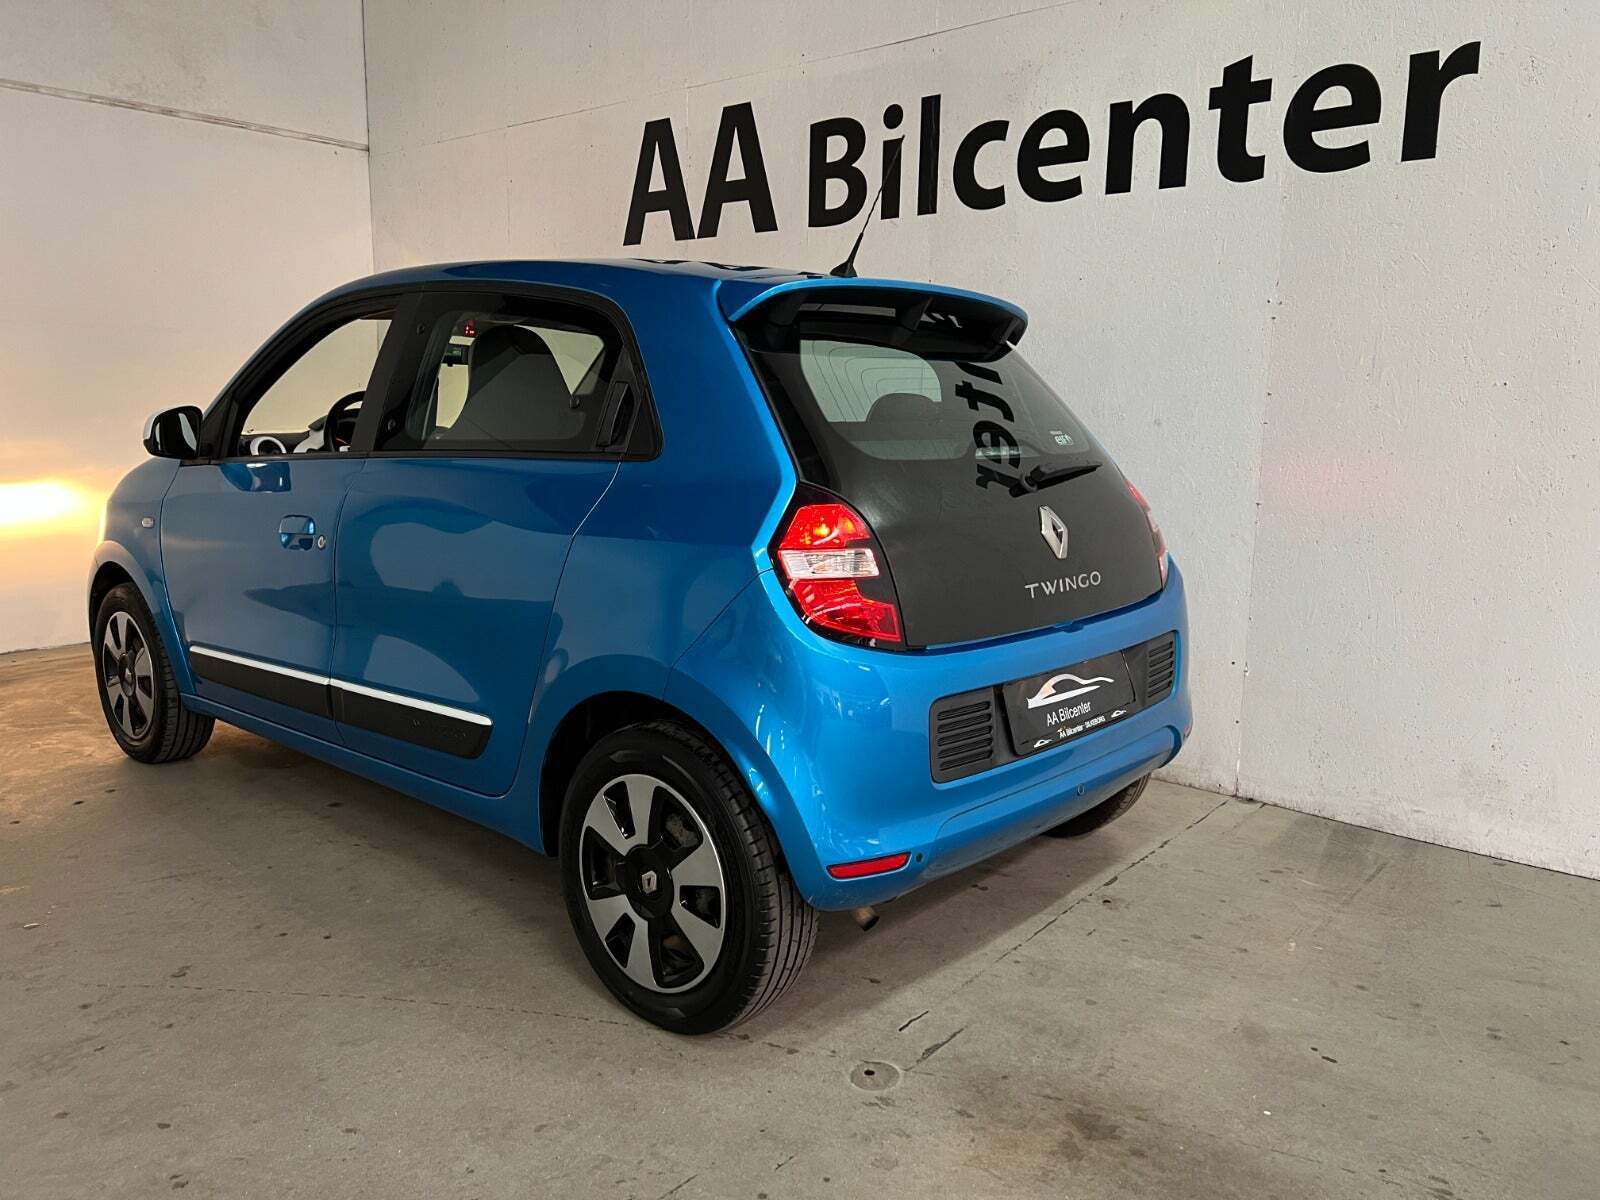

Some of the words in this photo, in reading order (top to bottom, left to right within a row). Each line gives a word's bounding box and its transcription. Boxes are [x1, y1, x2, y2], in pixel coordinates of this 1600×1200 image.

[623, 101, 779, 246] AA
[808, 41, 1481, 228] Bilcenter
[1024, 571, 1101, 599] TWINGO
[1046, 711, 1059, 727] AA
[1059, 701, 1091, 722] Bilcenter
